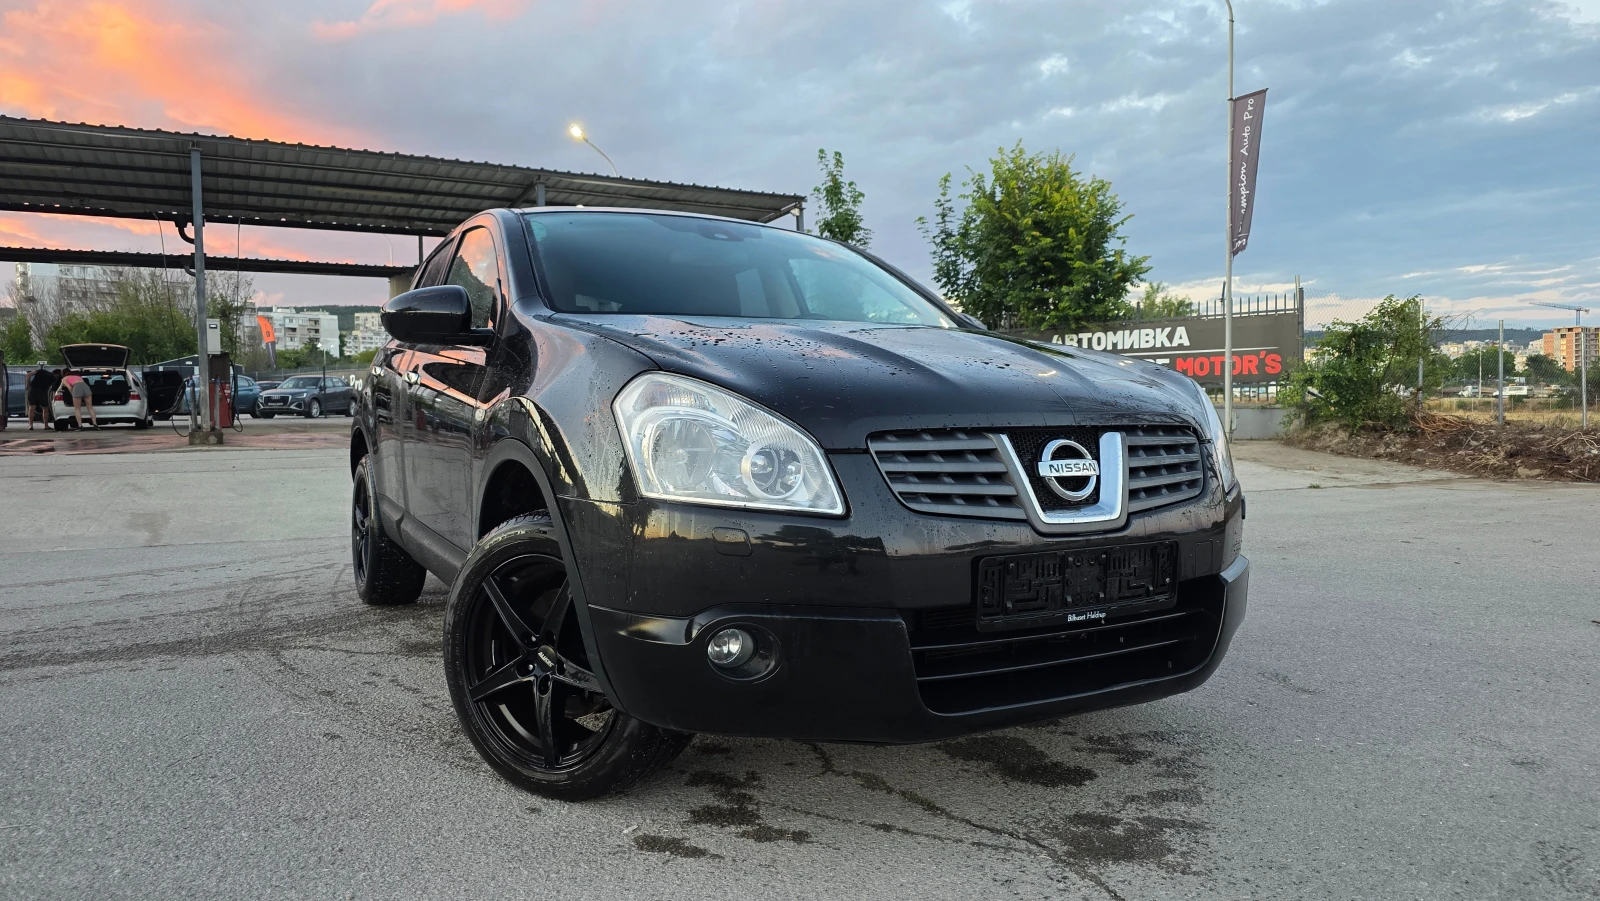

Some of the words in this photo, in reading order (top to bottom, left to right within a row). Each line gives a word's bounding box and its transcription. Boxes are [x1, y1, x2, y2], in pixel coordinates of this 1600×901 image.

[1243, 98, 1255, 121] Pro
[1240, 126, 1251, 156] Auto
[1238, 161, 1250, 215] mpion
[1048, 462, 1097, 473] NISSAN
